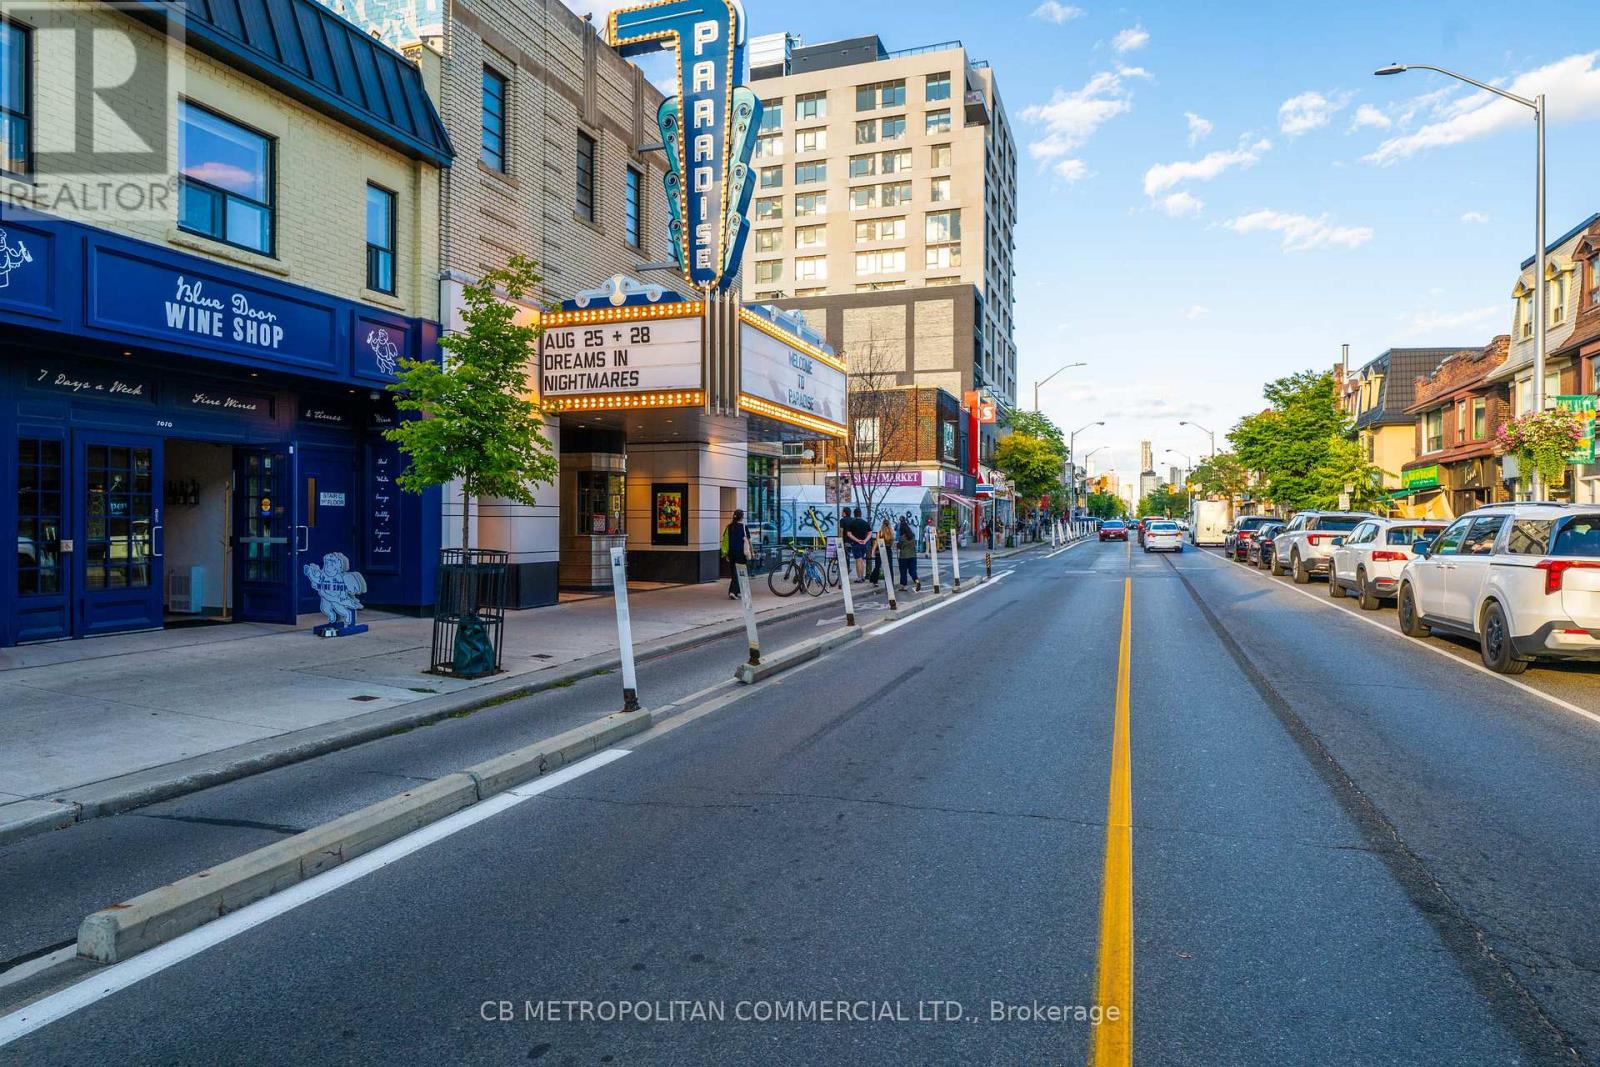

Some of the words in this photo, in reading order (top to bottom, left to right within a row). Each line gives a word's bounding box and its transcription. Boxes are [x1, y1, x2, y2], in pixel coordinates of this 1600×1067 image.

[692, 19, 719, 270] PARADISE
[176, 275, 224, 310] Blue
[231, 293, 277, 322] Door
[165, 301, 223, 337] WINE
[232, 317, 284, 348] SHOP
[545, 331, 575, 350] AUG
[584, 329, 604, 347] 25
[612, 330, 622, 341] +
[630, 326, 651, 344] 28
[544, 351, 606, 371] DREAMS
[614, 349, 628, 367] IN
[788, 351, 813, 375] WELCOME
[37, 369, 48, 381] 7
[54, 373, 91, 391] Days
[109, 381, 142, 395] Week
[544, 370, 640, 391] NIGHTMARES
[797, 373, 805, 390] TO
[192, 392, 221, 406] Fine
[223, 397, 257, 410] Wines
[788, 388, 815, 411] PARADISE
[881, 472, 918, 482] MARKET
